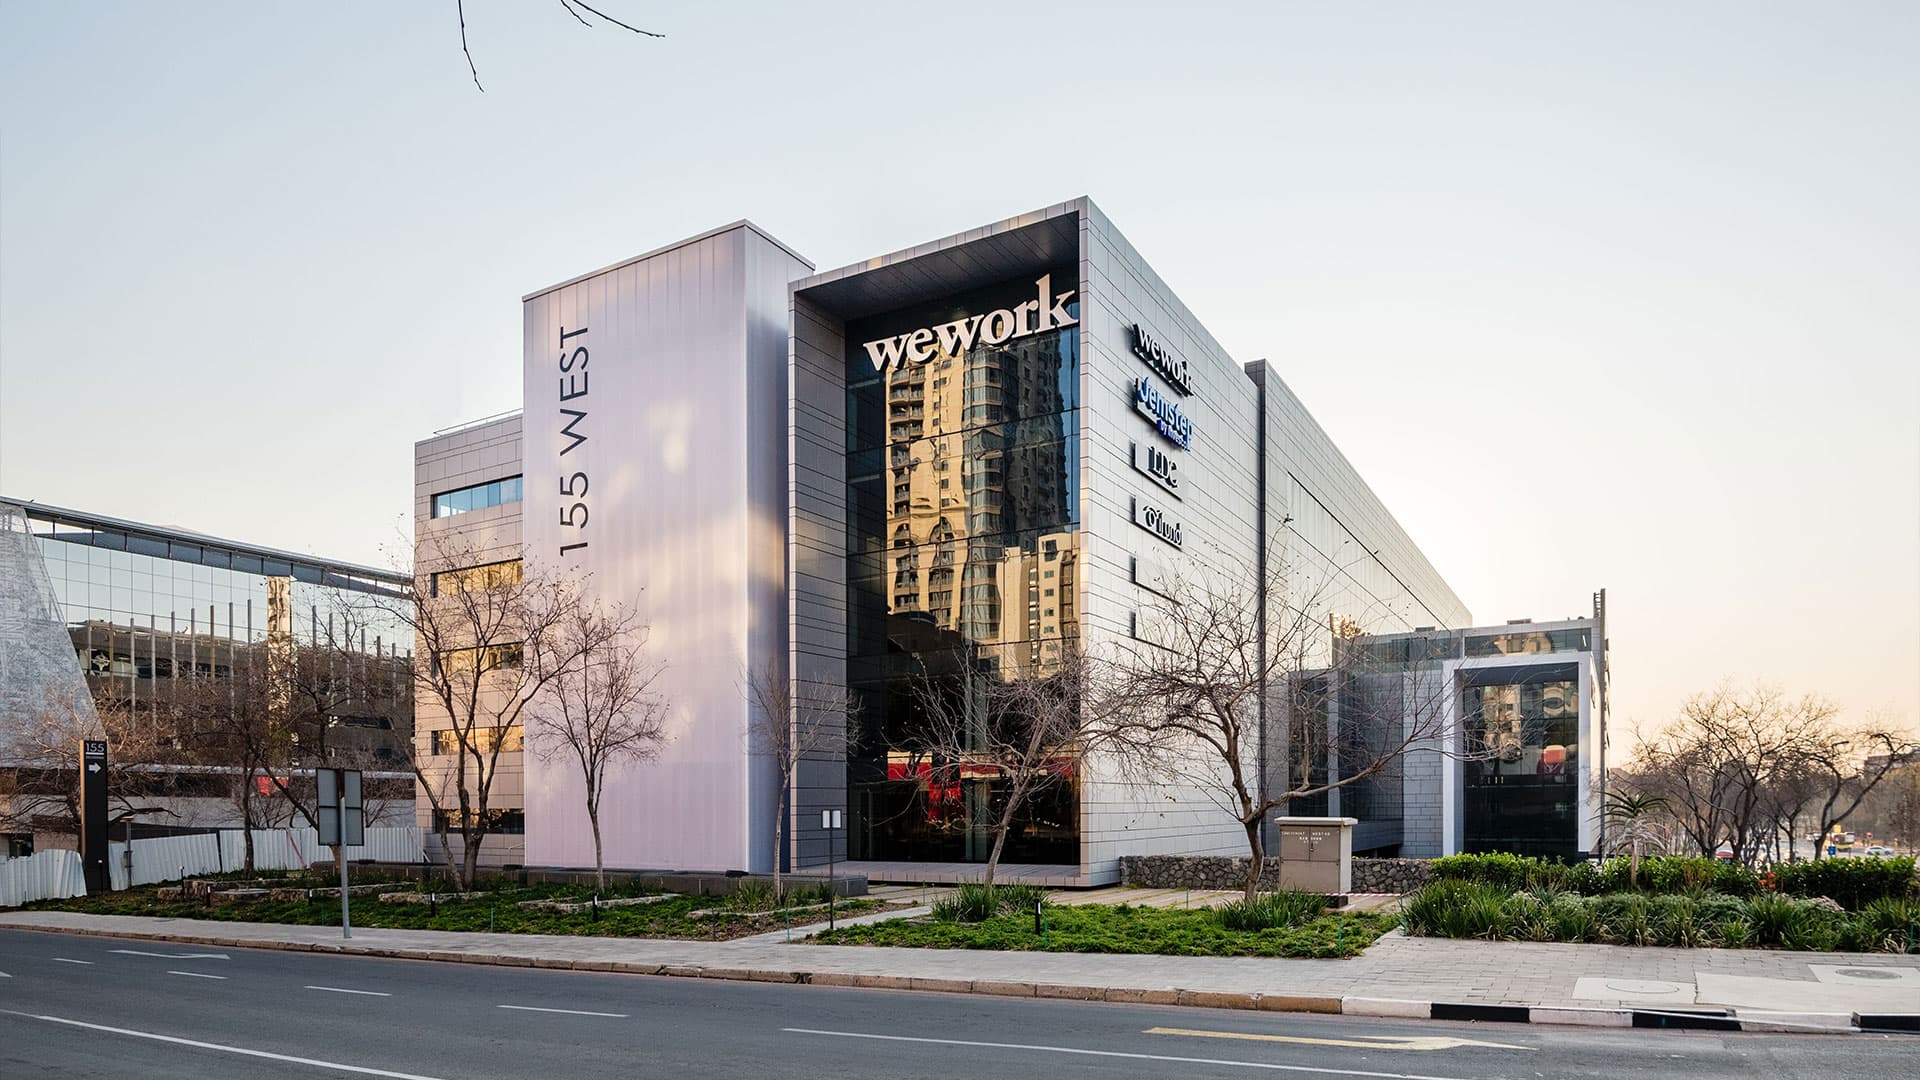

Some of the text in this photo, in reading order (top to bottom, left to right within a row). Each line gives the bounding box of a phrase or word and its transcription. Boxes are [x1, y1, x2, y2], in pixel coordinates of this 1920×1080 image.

[863, 273, 1079, 371] wework
[559, 326, 589, 557] 155 WEST
[86, 743, 104, 752] 155
